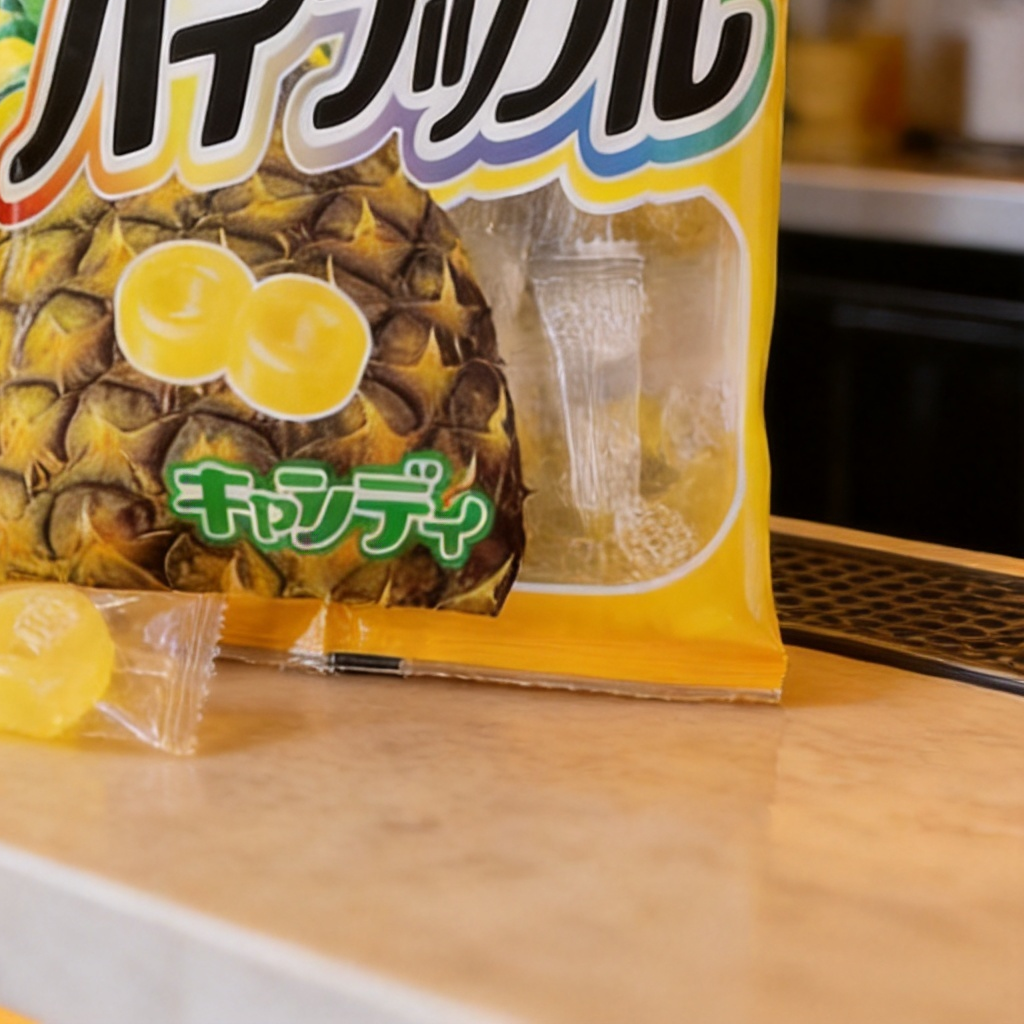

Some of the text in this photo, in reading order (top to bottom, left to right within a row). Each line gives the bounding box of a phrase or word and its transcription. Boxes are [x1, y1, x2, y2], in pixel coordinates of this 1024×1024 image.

[169, 454, 491, 566] キャンディ
